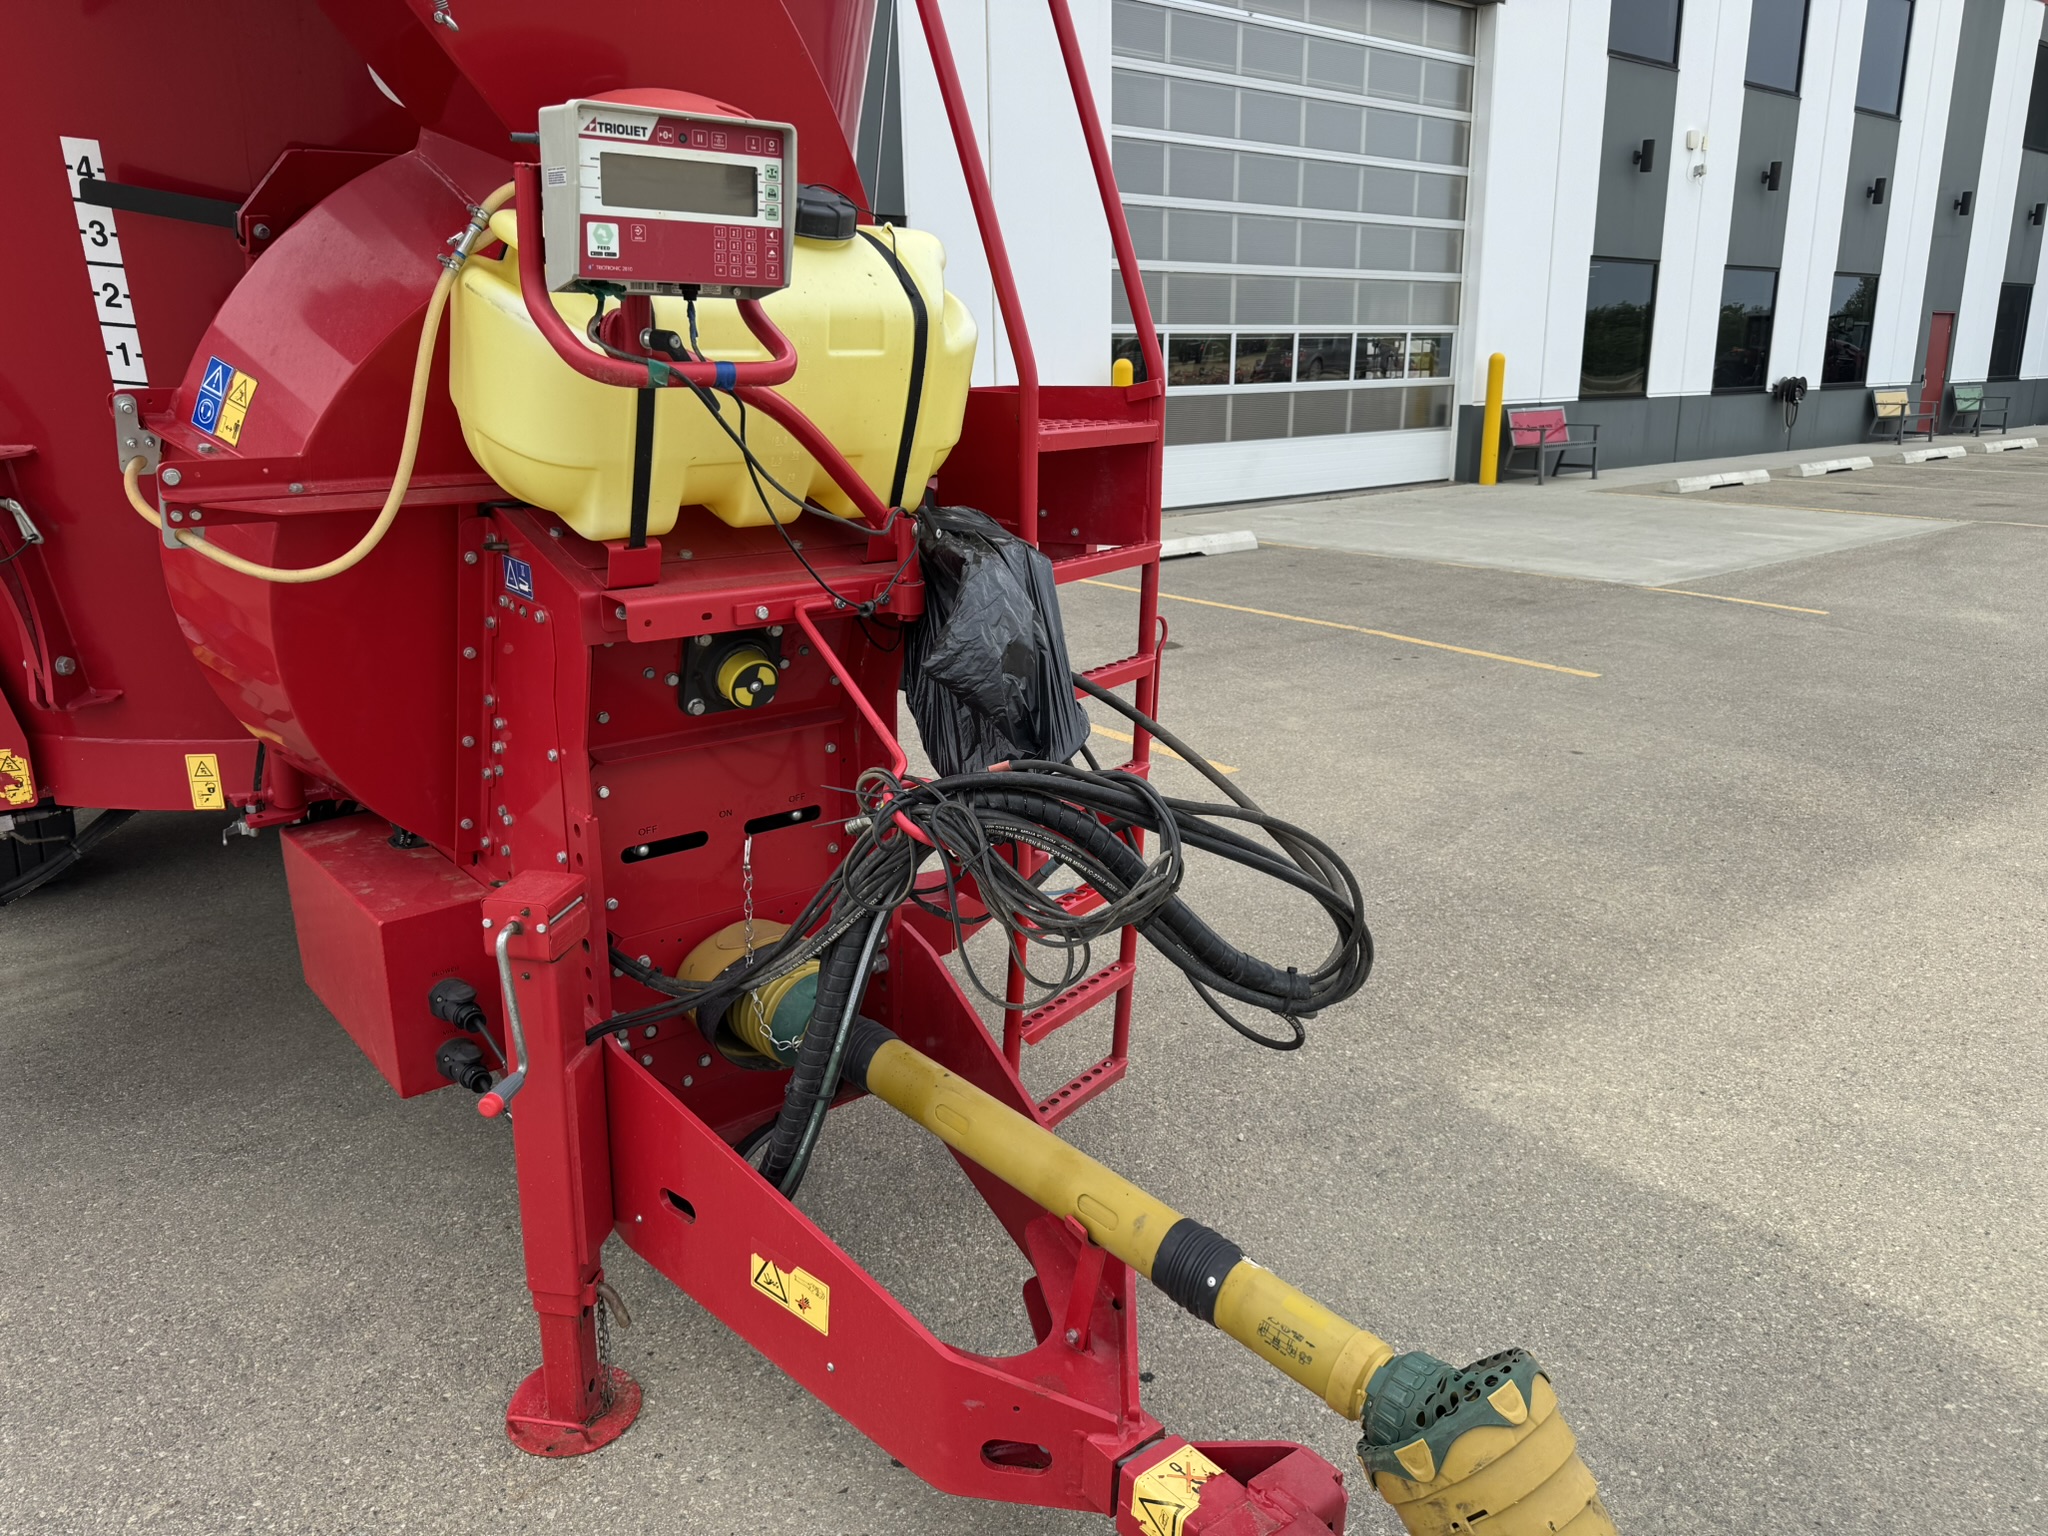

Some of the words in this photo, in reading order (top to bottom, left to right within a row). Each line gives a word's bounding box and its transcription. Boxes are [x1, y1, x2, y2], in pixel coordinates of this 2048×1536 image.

[597, 122, 648, 138] TRIOLIET
[76, 156, 96, 179] 4
[88, 220, 109, 247] 3
[102, 282, 122, 308] 2
[116, 342, 130, 366] 1
[788, 792, 806, 804] OFF
[718, 809, 733, 818] ON
[638, 825, 658, 836] OFF
[1060, 854, 1072, 862] BAR
